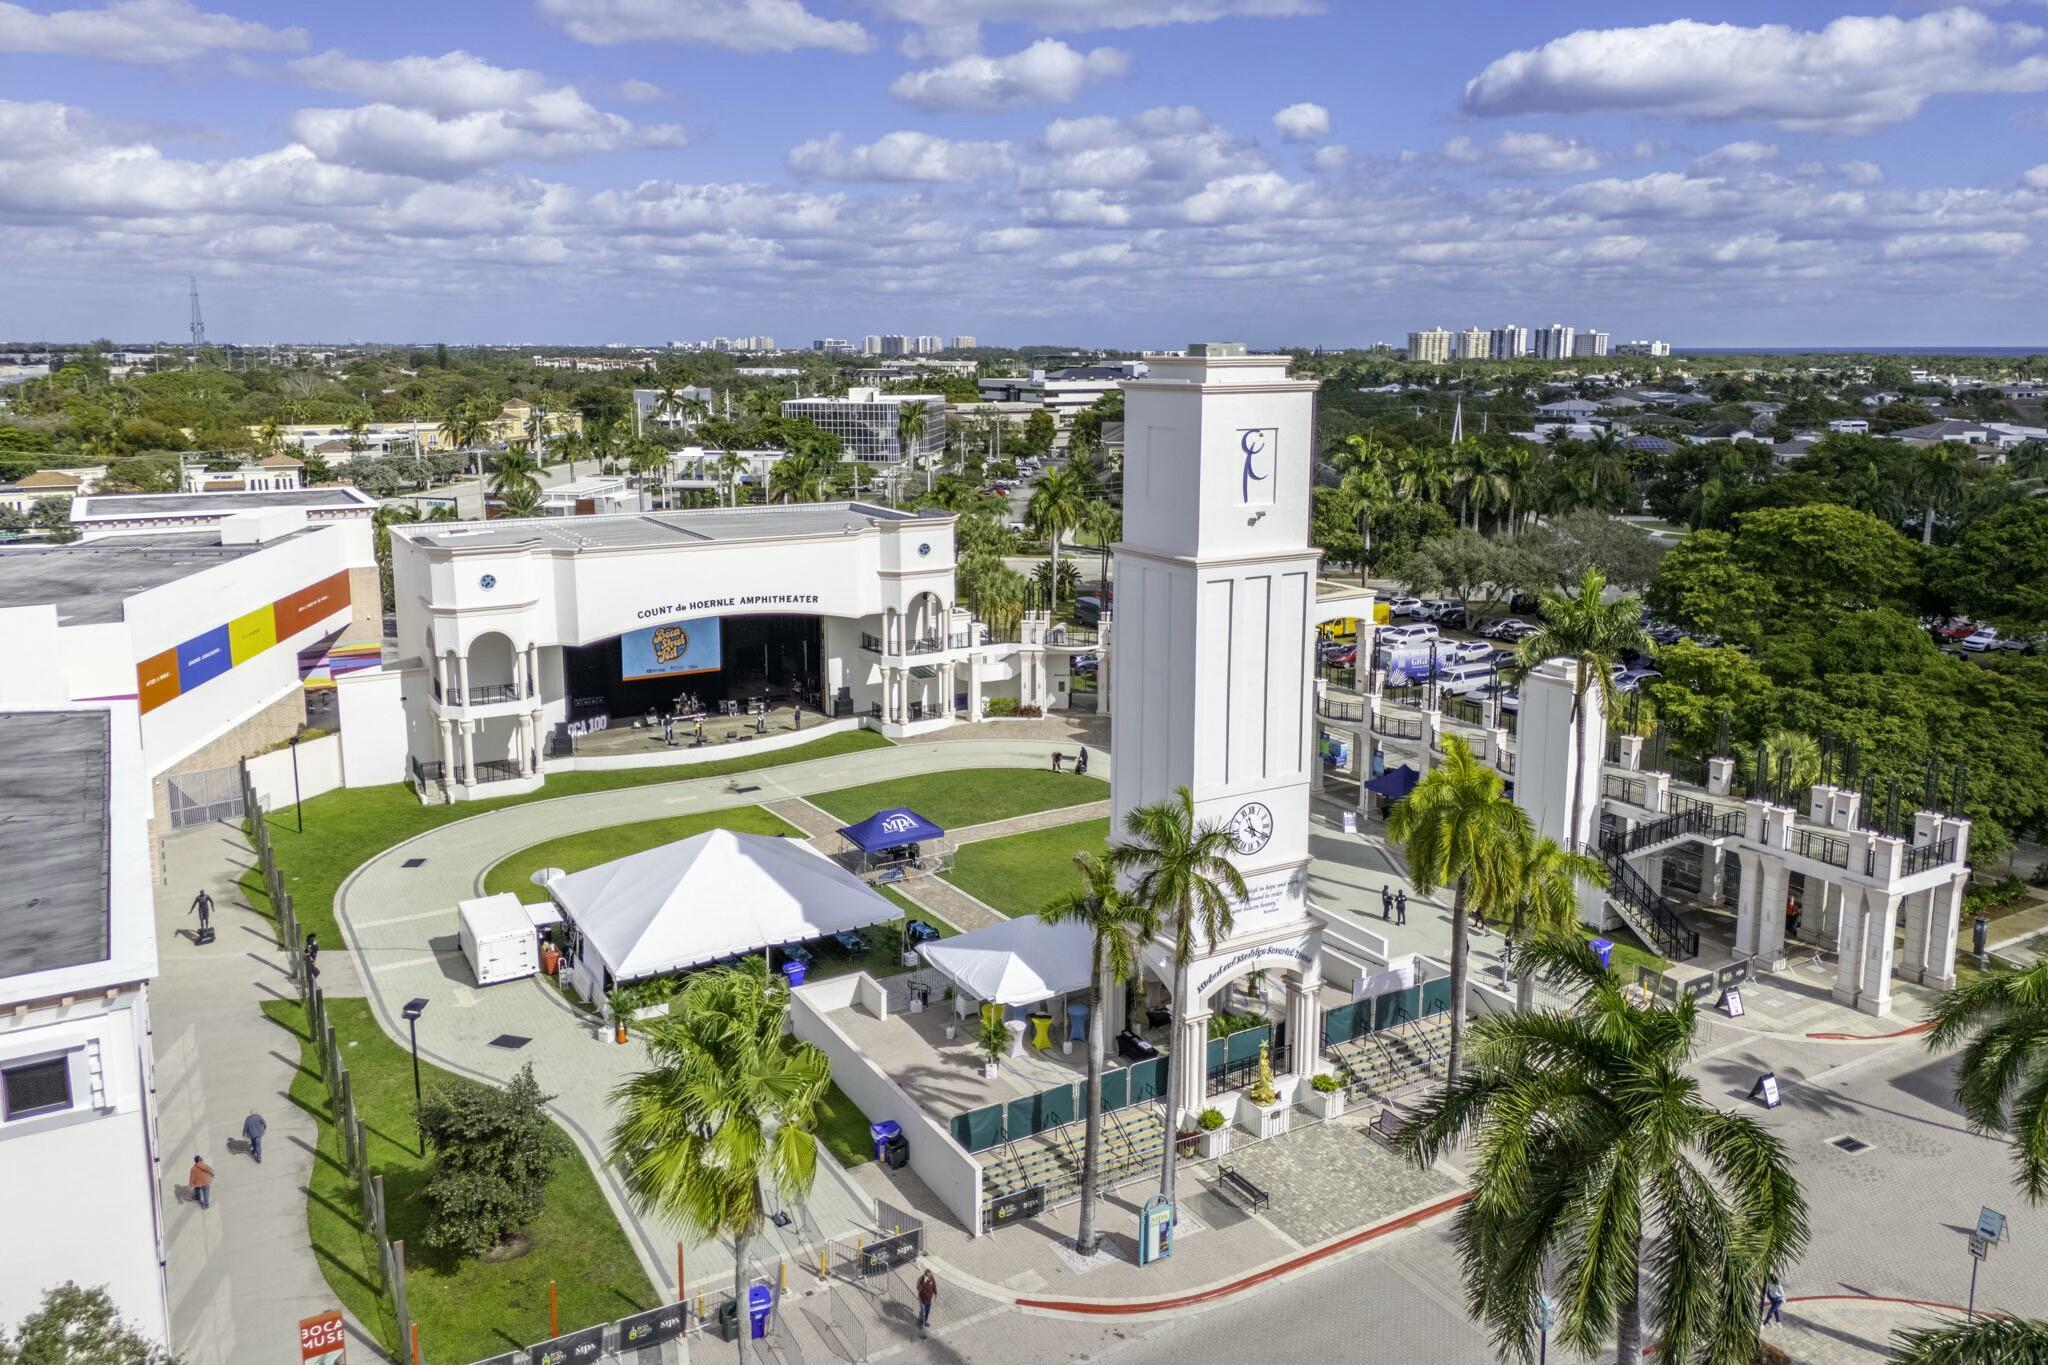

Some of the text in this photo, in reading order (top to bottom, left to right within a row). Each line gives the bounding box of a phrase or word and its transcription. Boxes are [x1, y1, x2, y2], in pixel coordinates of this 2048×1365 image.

[637, 594, 819, 619] COUNT de HOERNLE AMPHITHEATER
[654, 627, 681, 644] Boca
[568, 715, 607, 737] OCA 100
[881, 818, 918, 833] MPA
[301, 1319, 343, 1340] BOCA
